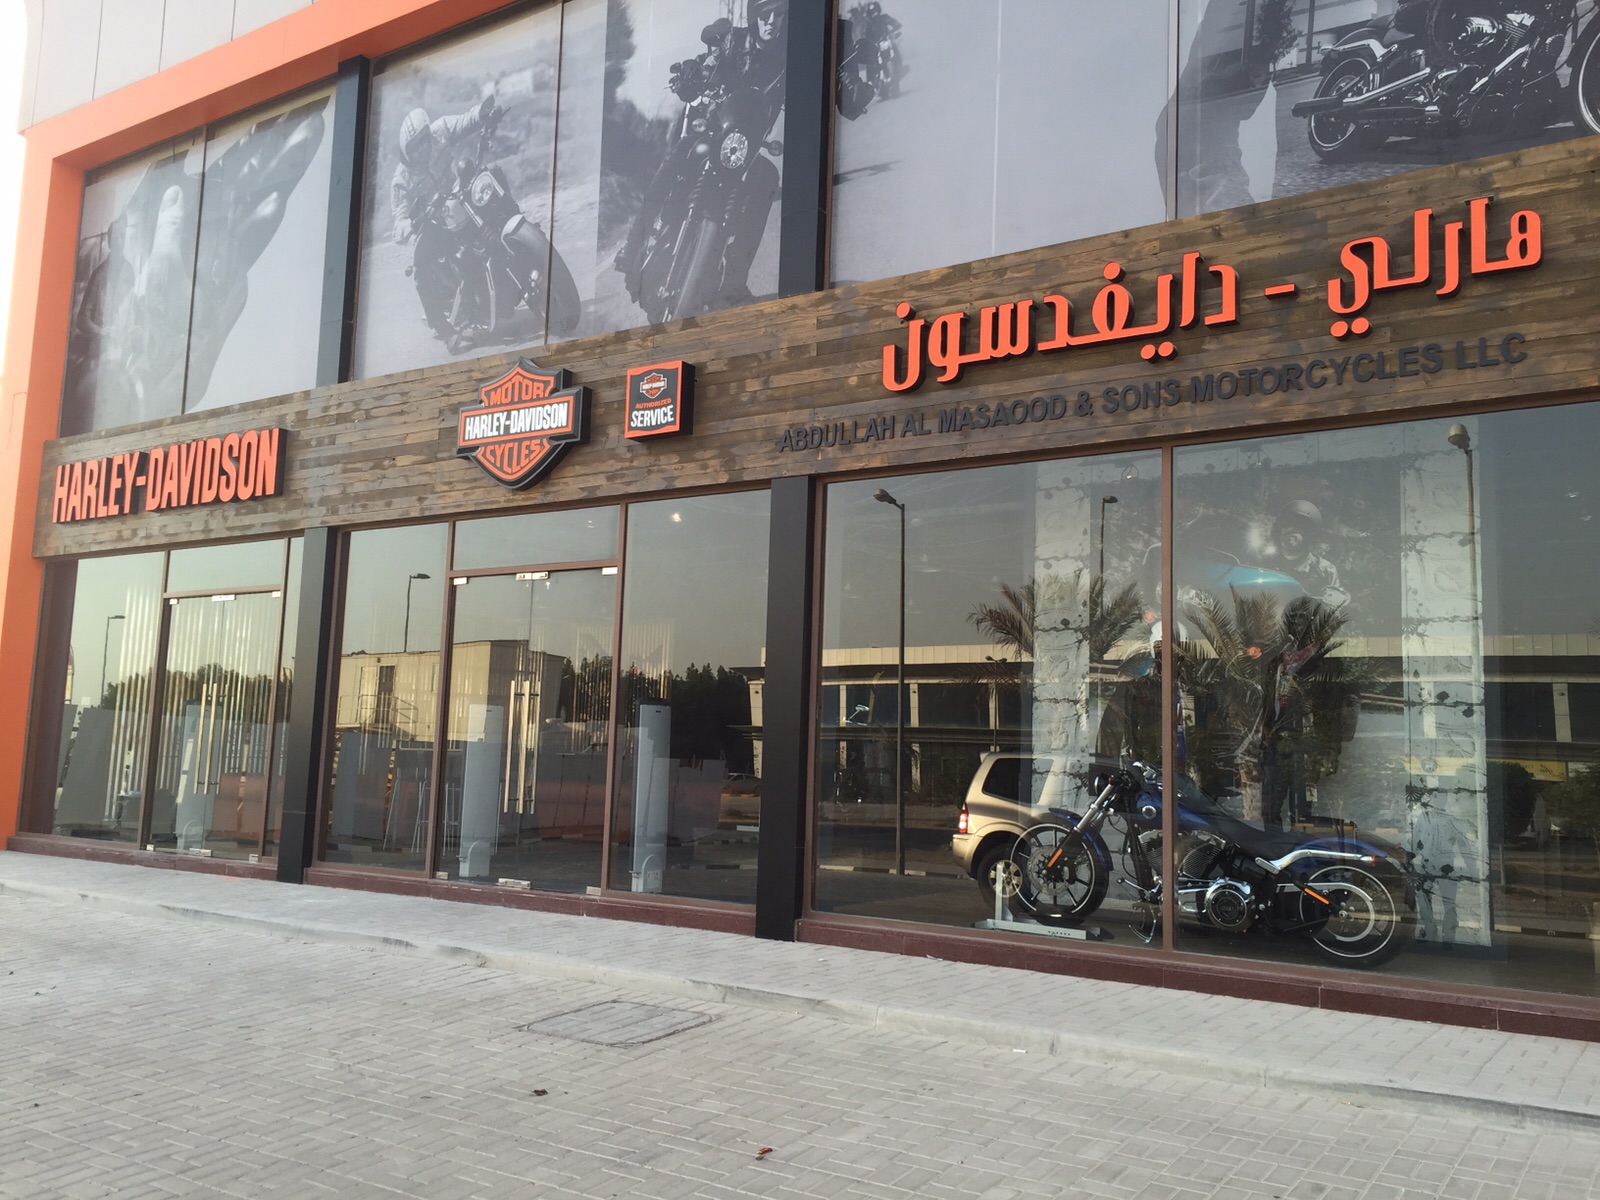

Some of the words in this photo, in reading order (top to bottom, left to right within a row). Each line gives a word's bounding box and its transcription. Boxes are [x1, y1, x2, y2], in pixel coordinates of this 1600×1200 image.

[1327, 198, 1543, 338] هارلي
[490, 376, 545, 406] MOTOR
[635, 398, 672, 409] AUTHORIZED
[779, 416, 895, 453] ABDULLAH
[900, 412, 932, 437] AL
[938, 395, 1067, 433] MASAOOD
[1076, 391, 1094, 417] &
[1101, 380, 1181, 414] SONS
[1189, 343, 1443, 403] MOTORCYCLES
[1456, 332, 1527, 371] LLC
[465, 402, 567, 440] HARLEY-DAVIDSON
[630, 404, 675, 428] SERVICE
[486, 438, 544, 473] CYCLES
[51, 427, 281, 524] HARLEY-DAVIDSON
